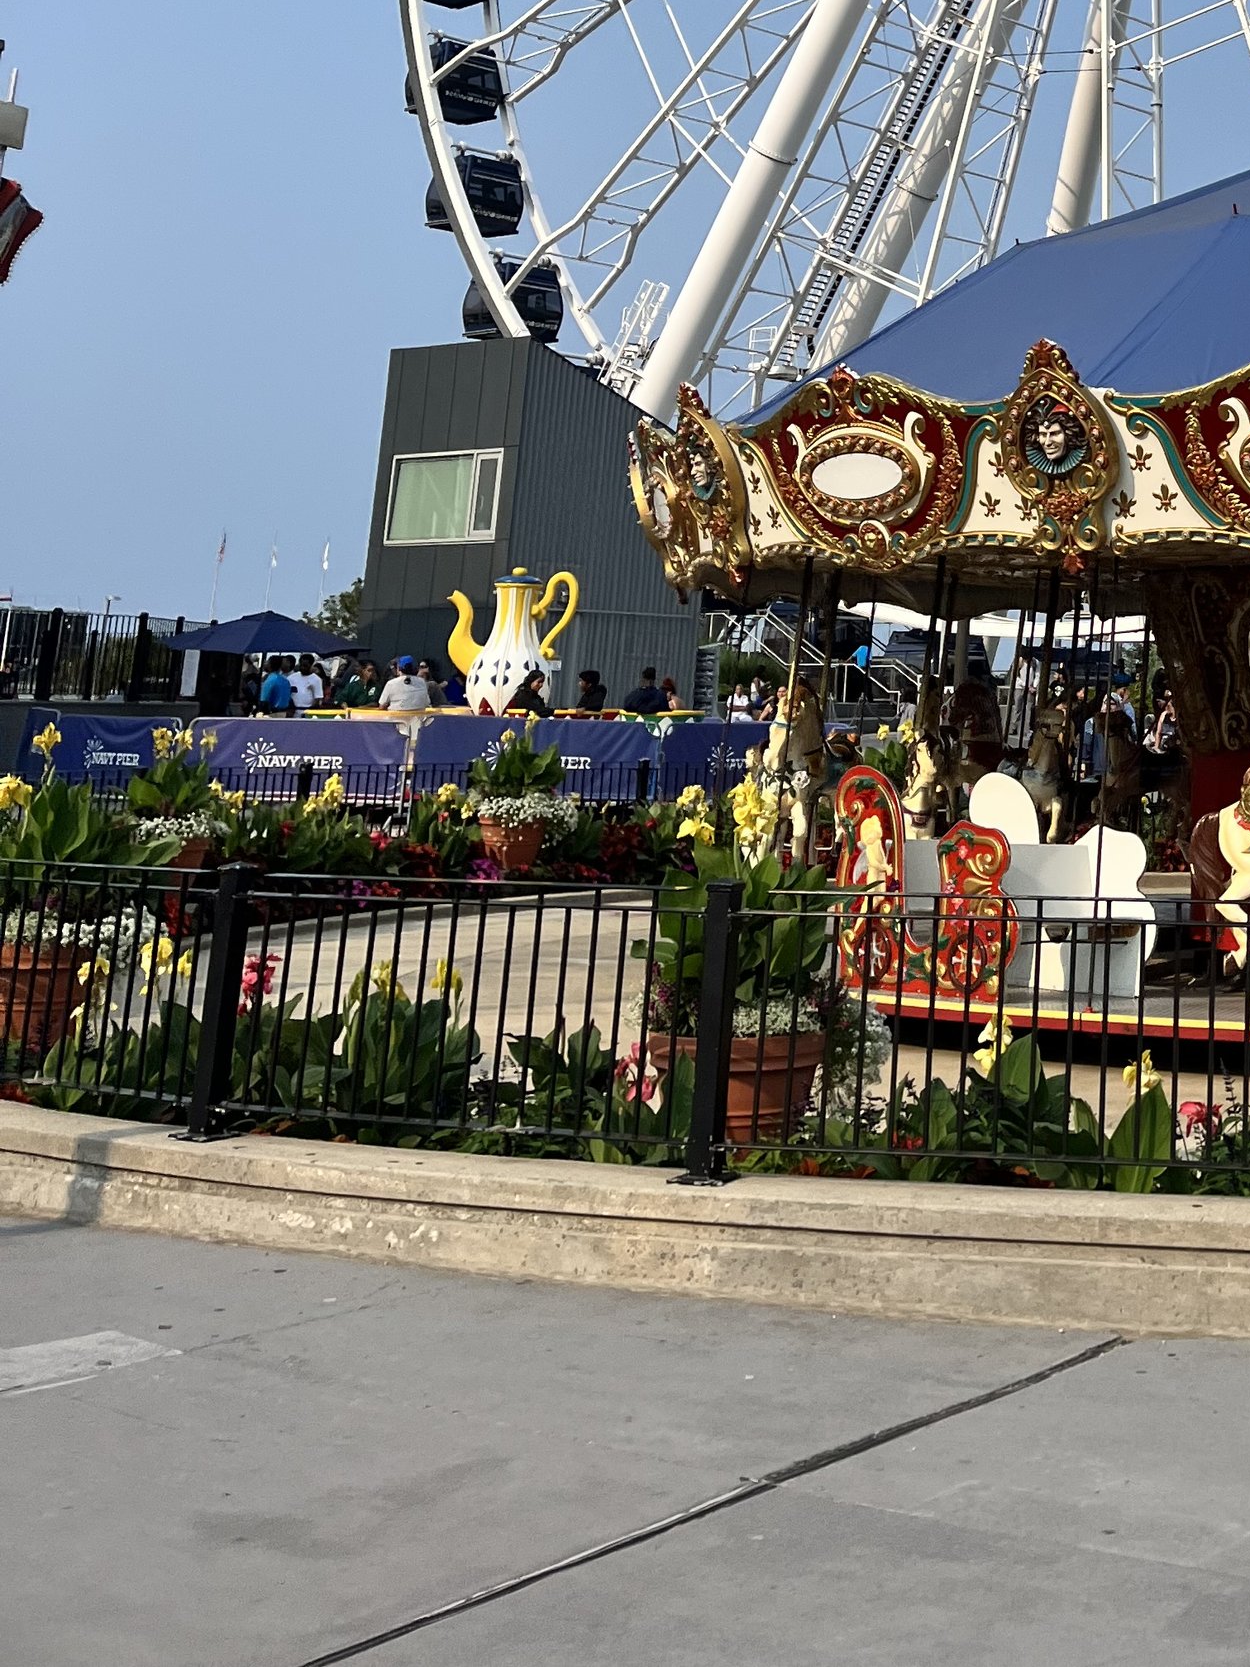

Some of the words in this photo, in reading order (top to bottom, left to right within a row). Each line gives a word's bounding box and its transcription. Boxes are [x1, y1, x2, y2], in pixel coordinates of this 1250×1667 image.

[115, 752, 140, 766] PIER
[257, 755, 301, 768] NAVY
[560, 756, 591, 770] IER
